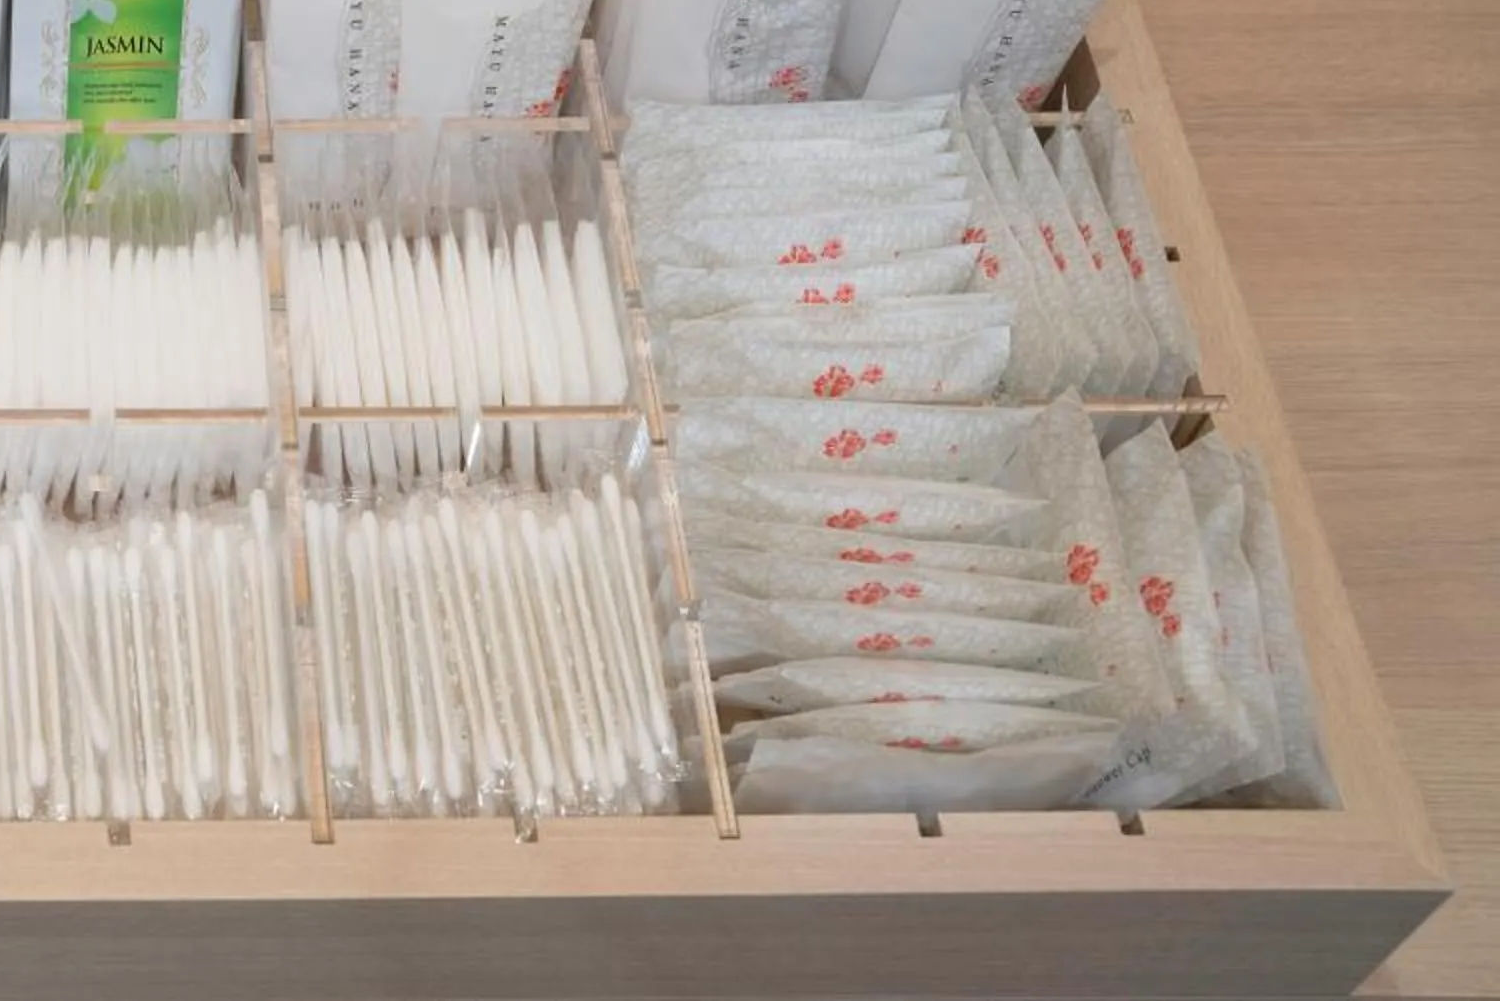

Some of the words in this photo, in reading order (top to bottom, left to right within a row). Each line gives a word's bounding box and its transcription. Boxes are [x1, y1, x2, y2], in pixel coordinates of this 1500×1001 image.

[87, 35, 165, 58] JASMIN
[489, 15, 510, 72] MAYU
[347, 48, 363, 111] HANA
